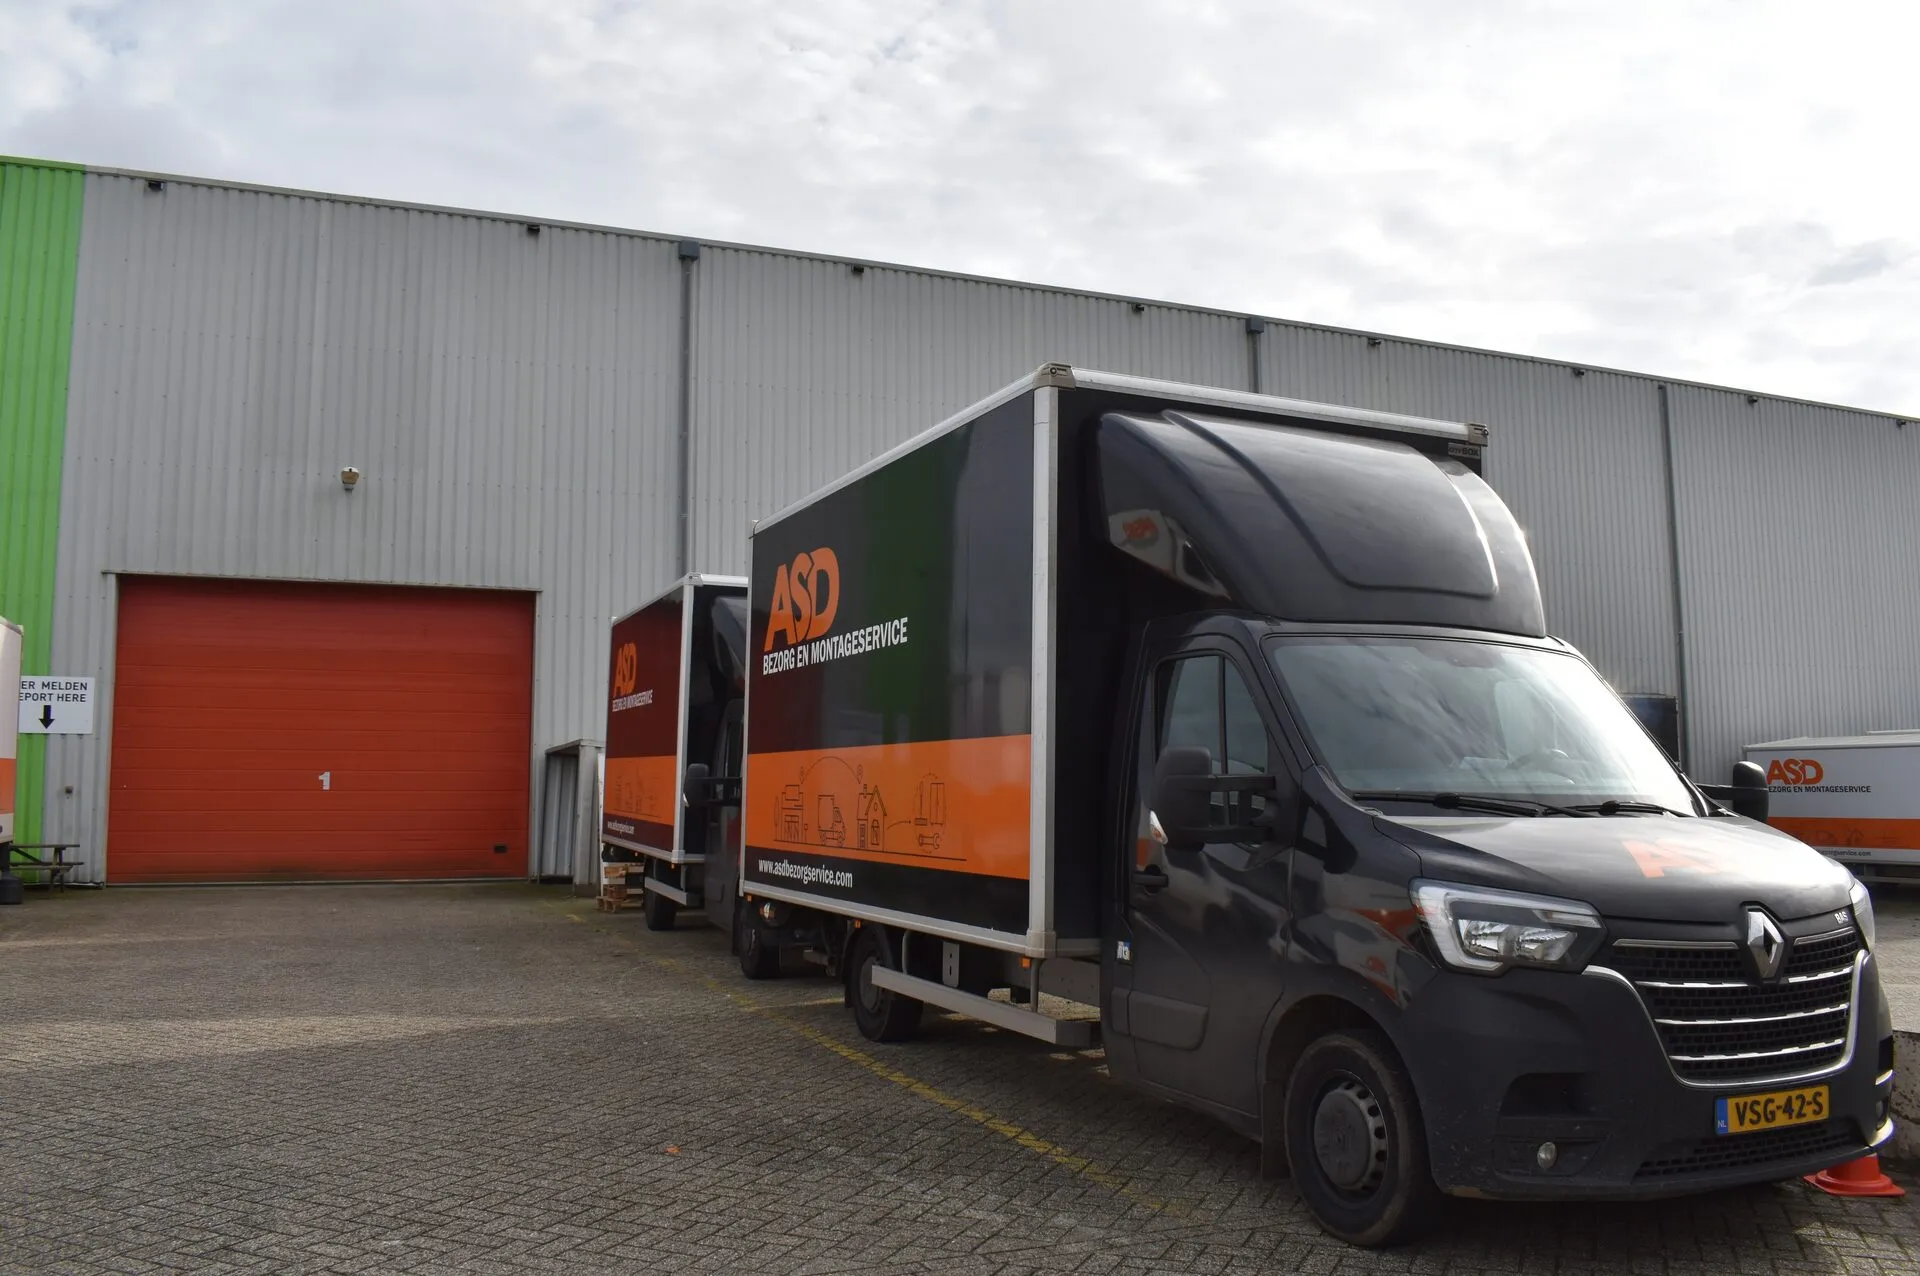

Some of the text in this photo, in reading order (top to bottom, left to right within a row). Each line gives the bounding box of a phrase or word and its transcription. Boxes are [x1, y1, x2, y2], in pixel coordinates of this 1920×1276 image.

[764, 547, 840, 653] ASD
[763, 617, 908, 676] BEZORG EN MONTAGESERVICE
[613, 642, 637, 698] ASD
[19, 692, 87, 702] EPORT HERE
[21, 680, 88, 691] ER MELDEN
[318, 771, 331, 791] 1
[1766, 758, 1824, 785] ASD
[1768, 785, 1872, 793] EZORG EN MONTAGESERVICE
[758, 859, 853, 888] www.asdbezorgservice.com
[1717, 1091, 1824, 1129] NL VSG-42-S
